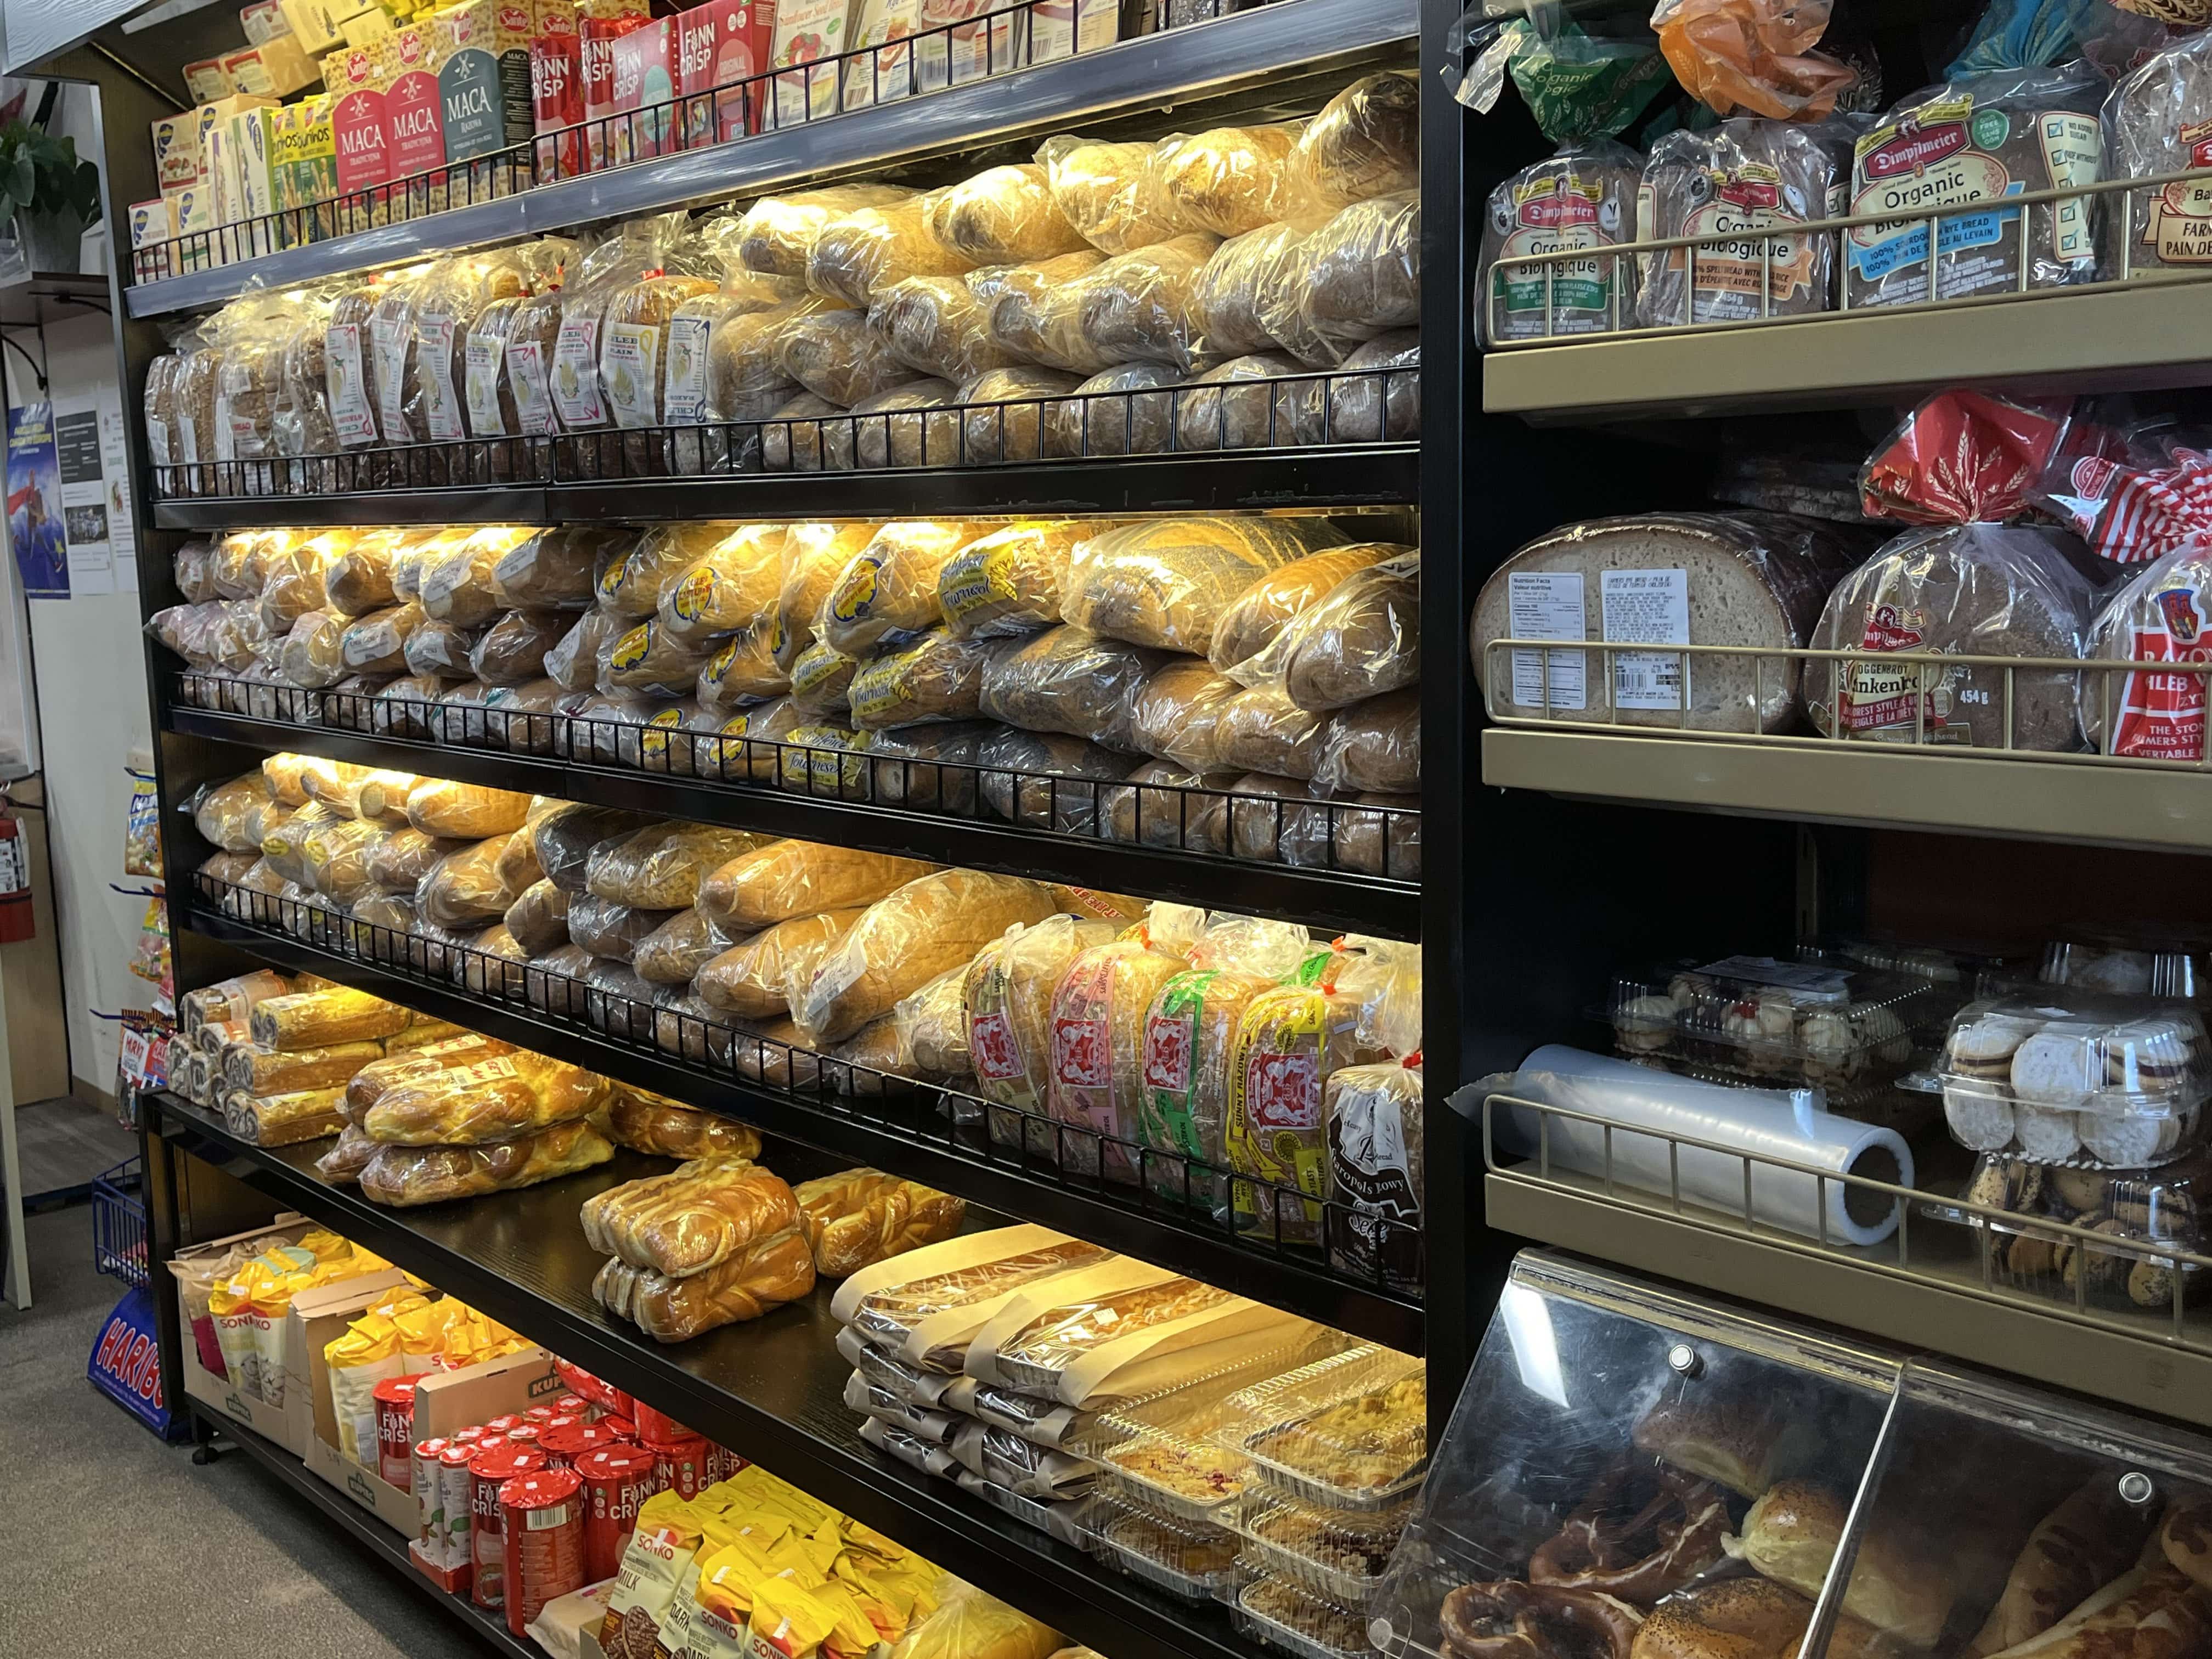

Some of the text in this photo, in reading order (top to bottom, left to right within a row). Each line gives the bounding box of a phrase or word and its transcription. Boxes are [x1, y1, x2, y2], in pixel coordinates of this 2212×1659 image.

[507, 53, 527, 61] MACA
[680, 48, 712, 77] CRISP
[582, 63, 613, 84] RISP
[532, 78, 565, 100] RISP
[613, 74, 639, 101] CRISP
[447, 86, 492, 123] MACA
[393, 107, 438, 140] MACA
[1979, 121, 1999, 130] FREE
[341, 124, 386, 156] MACA
[1875, 131, 1959, 170] Dimpflmeier
[1885, 171, 1965, 208] Organic
[1866, 258, 1891, 274] 100%
[1910, 245, 1922, 256] DE
[1964, 228, 1994, 241] LEVAIN
[1870, 246, 1894, 261] 100%
[1944, 222, 1960, 233] RYE
[1961, 217, 1990, 229] BREAD
[2166, 241, 2194, 256] PAIN
[1733, 278, 1751, 286] AVEC
[1960, 690, 1979, 703] 454
[1981, 691, 1989, 705] g
[1875, 714, 1885, 723] DE
[1886, 712, 1895, 721] LA
[2150, 725, 2171, 735] THE
[1235, 1098, 1245, 1128] SUNNY
[1344, 1119, 1363, 1134] Heavy
[637, 1534, 674, 1561] SONKO
[618, 1568, 642, 1592] MILK
[701, 1610, 738, 1640] SONKO
